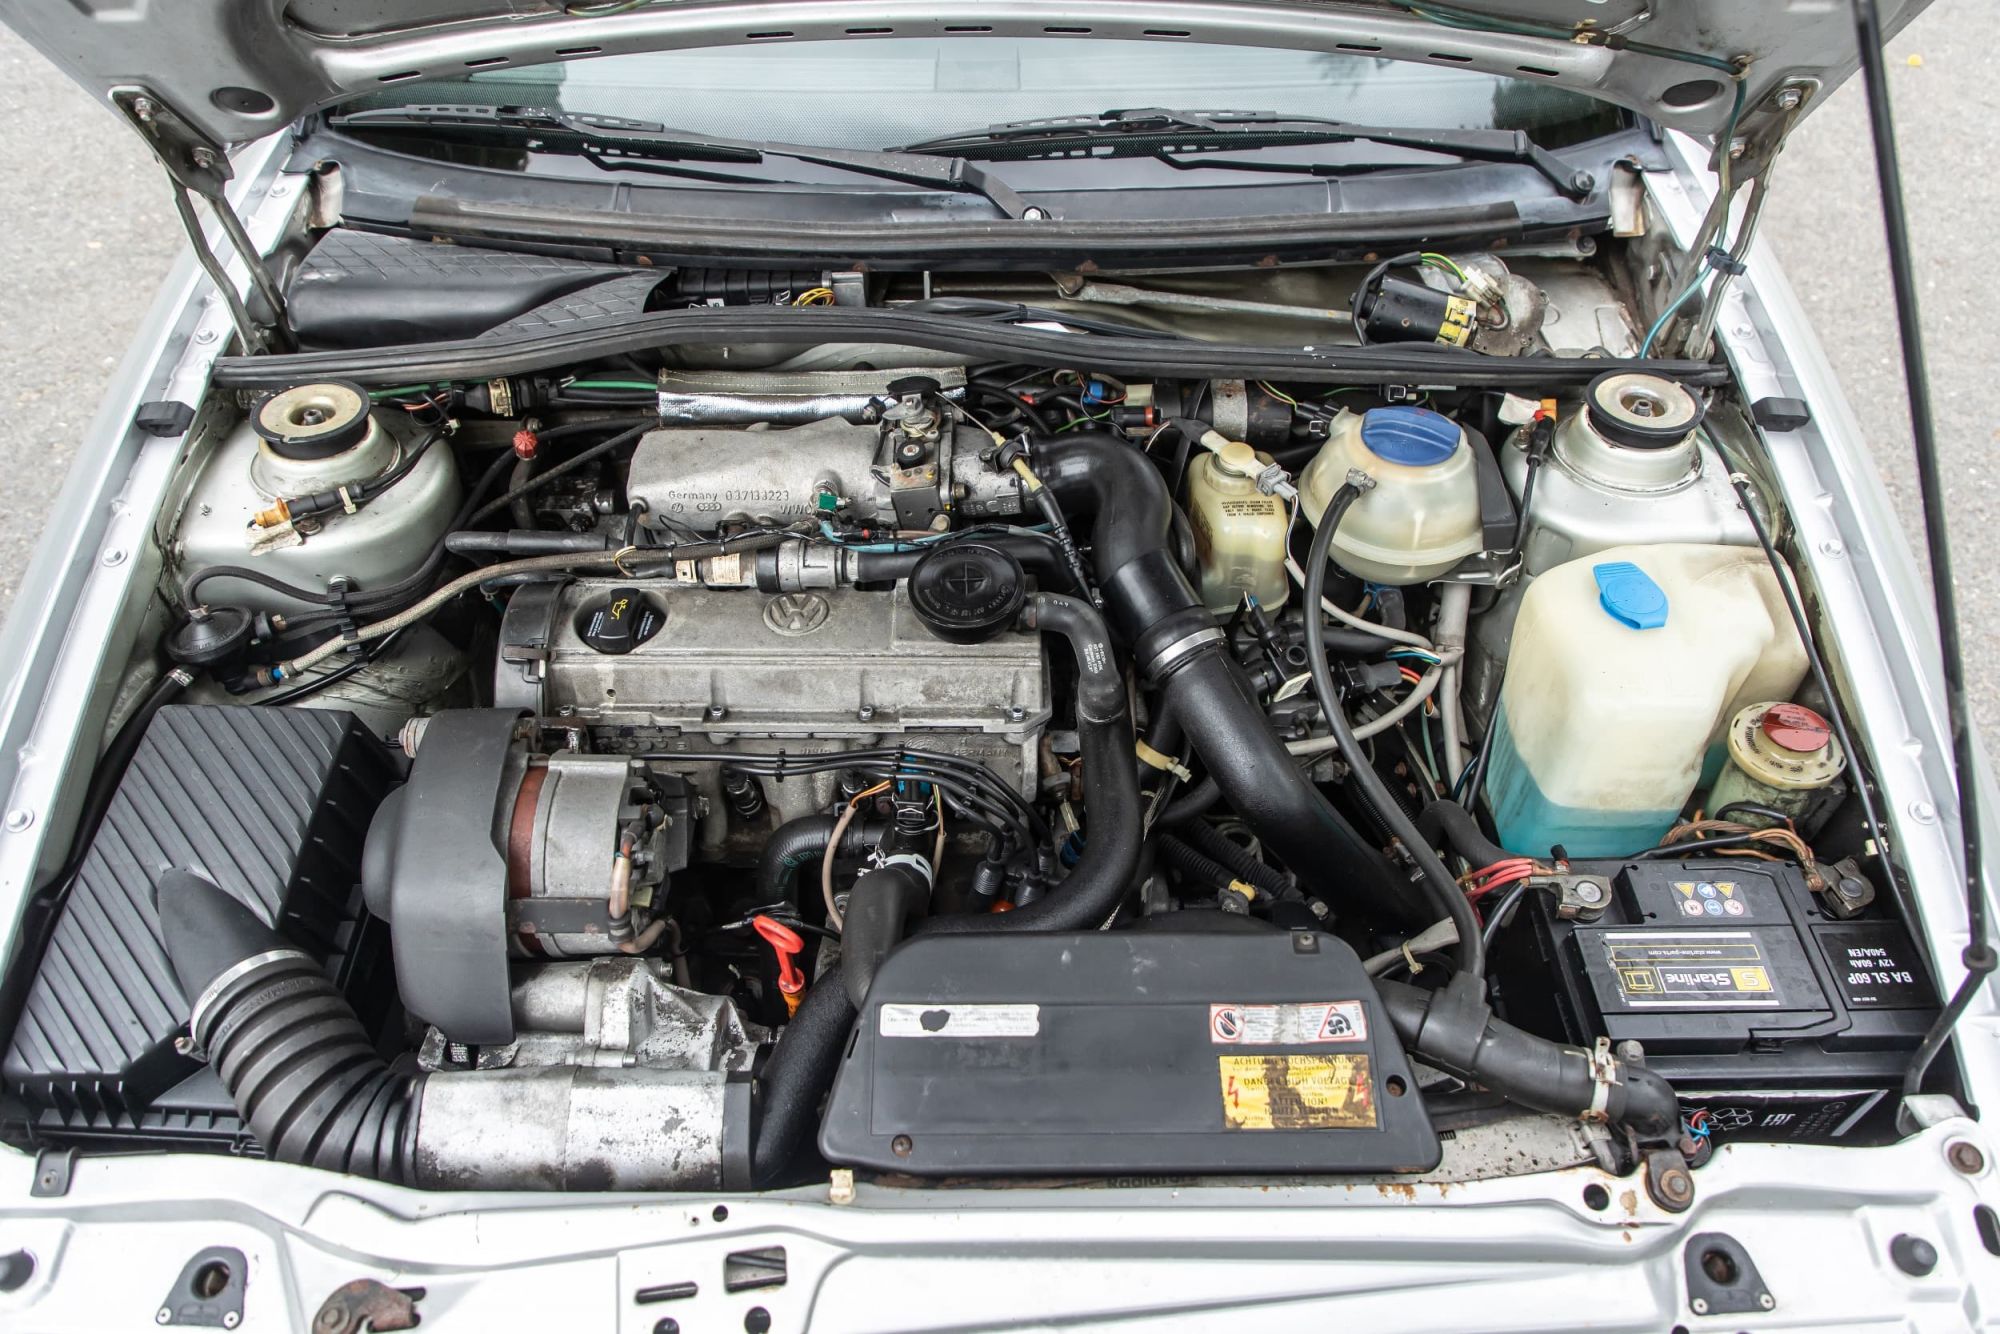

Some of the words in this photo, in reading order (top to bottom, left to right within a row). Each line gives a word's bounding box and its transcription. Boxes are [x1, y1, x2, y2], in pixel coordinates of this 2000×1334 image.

[668, 490, 718, 501] Germany
[1847, 947, 1887, 957] 540A/EN
[1849, 959, 1873, 968] 60Ah
[1878, 959, 1895, 968] 12V
[1665, 972, 1732, 986] Starline
[1847, 972, 1872, 985] 60P
[1871, 972, 1891, 984] SL
[1890, 971, 1913, 983] BA
